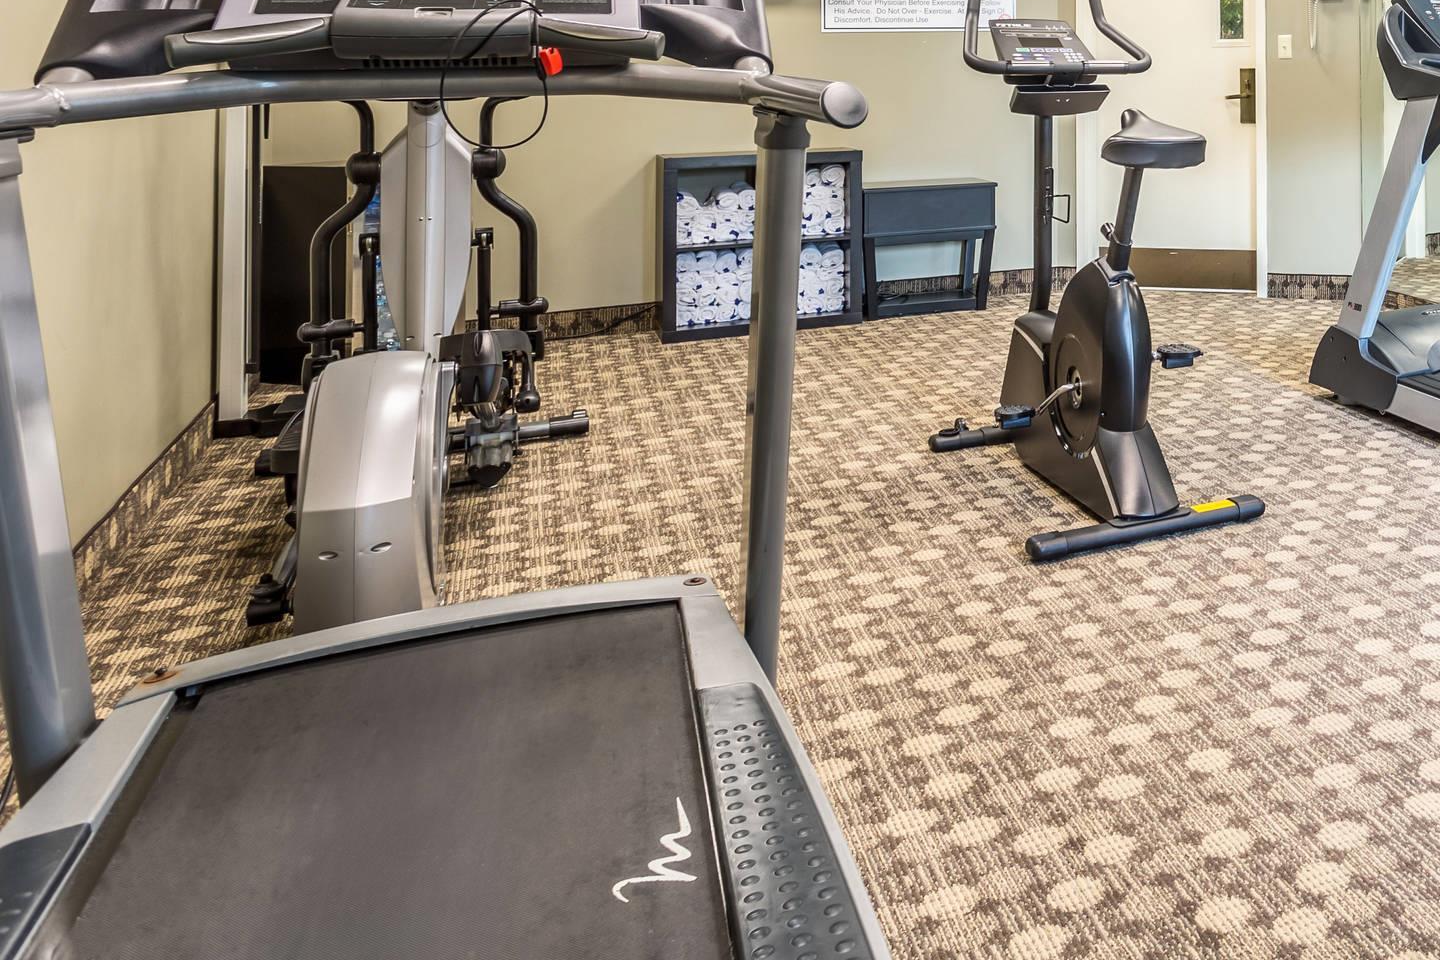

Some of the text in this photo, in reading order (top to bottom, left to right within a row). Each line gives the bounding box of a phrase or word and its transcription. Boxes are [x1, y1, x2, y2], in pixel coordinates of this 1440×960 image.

[875, 0, 906, 7] Physician
[931, 0, 965, 7] Exercising
[981, 7, 996, 15] Sign
